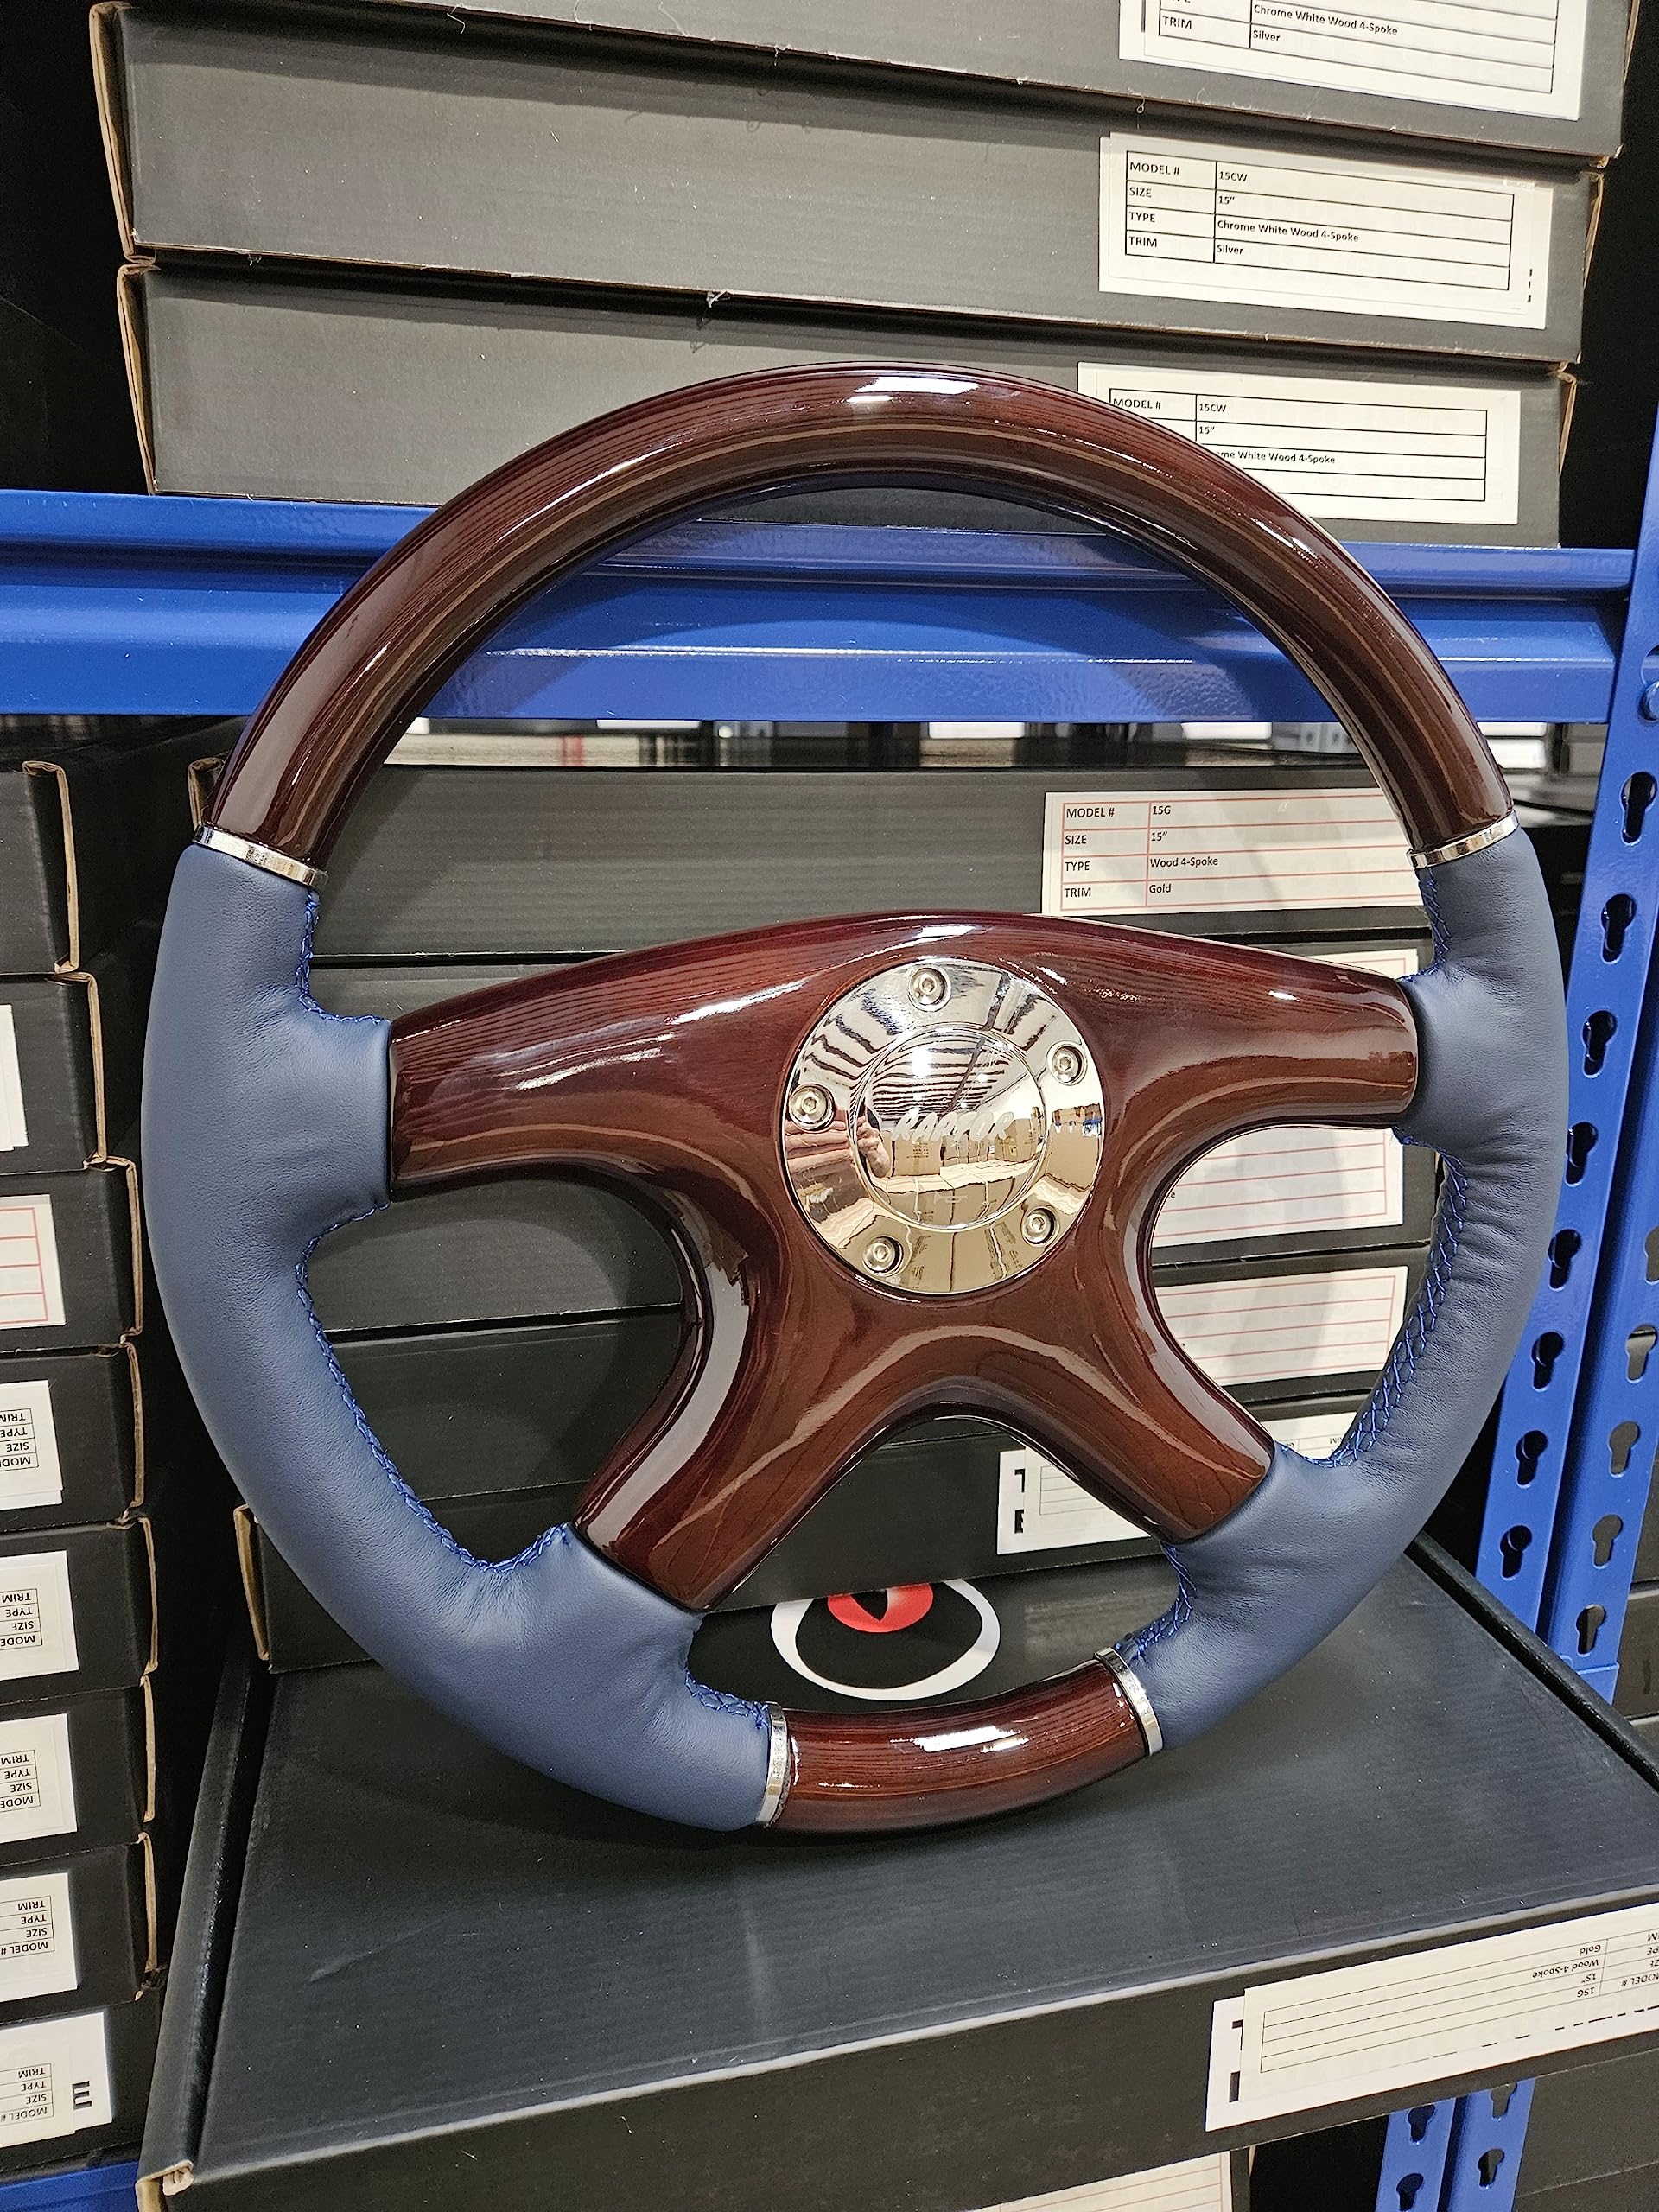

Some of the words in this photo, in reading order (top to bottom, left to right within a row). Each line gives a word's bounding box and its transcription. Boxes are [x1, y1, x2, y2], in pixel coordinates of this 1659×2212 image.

[1162, 16, 1192, 29] TRIM
[1254, 4, 1294, 19] Chrome
[1295, 10, 1325, 24] White
[1328, 16, 1357, 29] Wood
[1359, 21, 1398, 35] 4-Spoke
[1253, 29, 1281, 42] Silver
[1129, 162, 1171, 175] MODEL
[1218, 171, 1248, 182] 15CW
[1129, 187, 1152, 198] SIZE
[1129, 211, 1156, 223] TYPE
[1217, 219, 1255, 232] Chrome
[1258, 224, 1287, 235] White
[1290, 227, 1319, 238] Wood
[1320, 230, 1359, 243] 4-Spoke
[1128, 236, 1158, 248] TRIM
[1217, 244, 1244, 255] Silver
[1113, 397, 1153, 409] MODEL
[1198, 404, 1226, 413] 15CW
[1238, 450, 1266, 461] White
[1268, 452, 1296, 461] Wood
[1298, 454, 1335, 464] 4-Spoke
[1066, 808, 1106, 817] MODEL
[1109, 807, 1115, 817] #
[1152, 805, 1171, 815] 15G
[1065, 835, 1087, 845] SIZE
[1065, 861, 1090, 872] TYPE
[1150, 858, 1178, 868] Wood
[1180, 856, 1218, 868] 4-Spoke
[1064, 887, 1091, 898] TRIM
[1149, 884, 1171, 893] Gold
[891, 1109, 1014, 1141] RAPTOR
[0, 1427, 28, 1438] TYPE
[6, 1442, 29, 1452] SIZE
[0, 1457, 31, 1467] MOD
[2, 1592, 31, 1603] TRIM
[5, 1607, 33, 1618] TYPE
[11, 1621, 34, 1631] SIZE
[1, 1754, 29, 1765] TRIM
[4, 1768, 31, 1780] TYPE
[10, 1783, 32, 1793] SIZE
[18, 1900, 46, 1910] TRIM
[21, 1914, 47, 1924] TYPE
[26, 1927, 48, 1938] SIZE
[10, 1941, 48, 1954] MODEL
[1580, 1944, 1601, 1956] Gold
[1572, 1959, 1599, 1972] Wood
[1532, 1965, 1570, 1979] 4-Spoke
[1577, 1986, 1595, 1998] 15G
[18, 2067, 46, 2079] TRIM
[21, 2081, 47, 2092] TYPE
[26, 2093, 47, 2105] SIZE
[9, 2107, 48, 2120] MODEL
